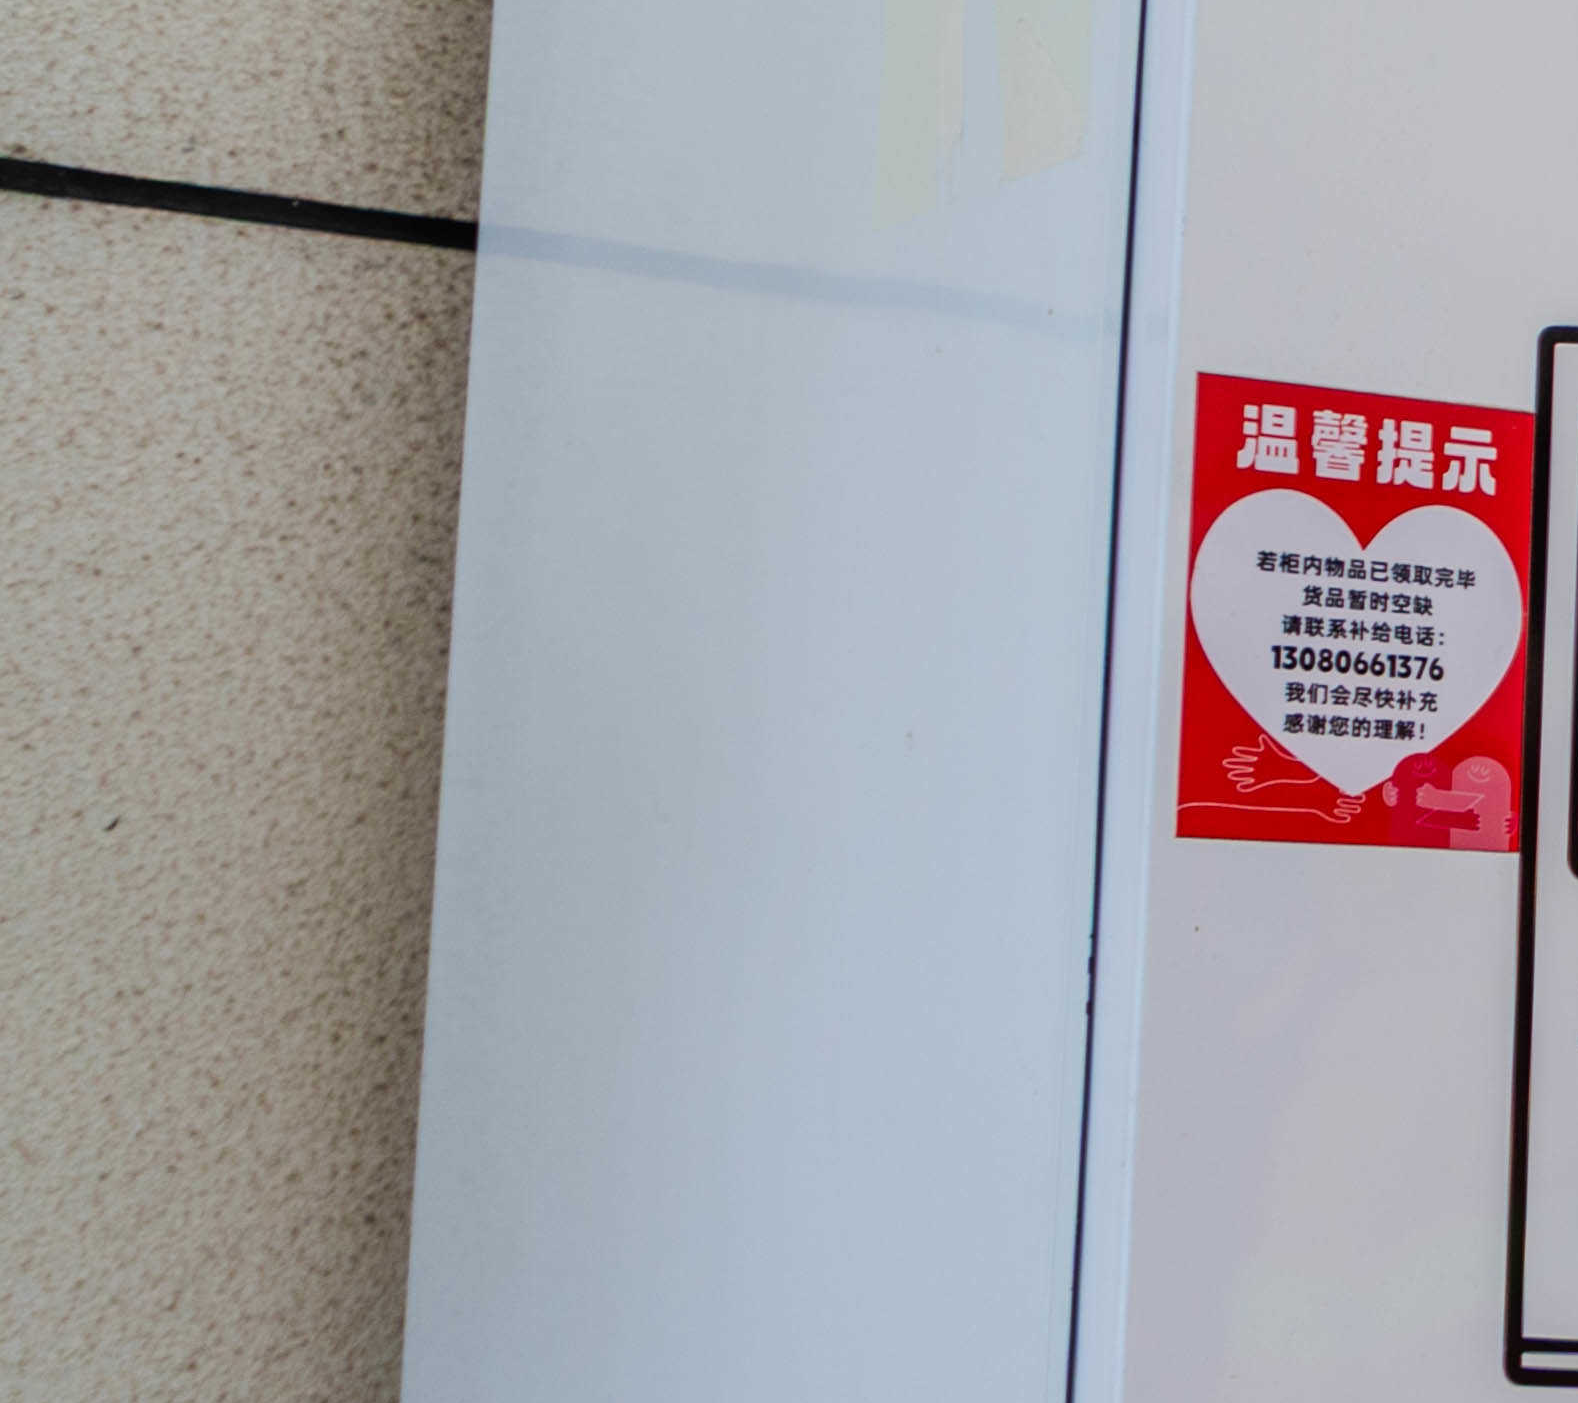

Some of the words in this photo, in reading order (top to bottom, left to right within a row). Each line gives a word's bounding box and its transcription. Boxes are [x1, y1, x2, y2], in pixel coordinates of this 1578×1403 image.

[1237, 403, 1499, 497] 温馨提示
[1256, 550, 1477, 590] 若柜内物品已领取完毕
[1301, 584, 1434, 617] 货品暂时空缺
[1281, 614, 1446, 647] 请联系补给电话：
[1271, 645, 1445, 682] 13080661376
[1285, 681, 1439, 713] 我们会尽快补充
[1282, 713, 1426, 741] 感谢您的理解！
